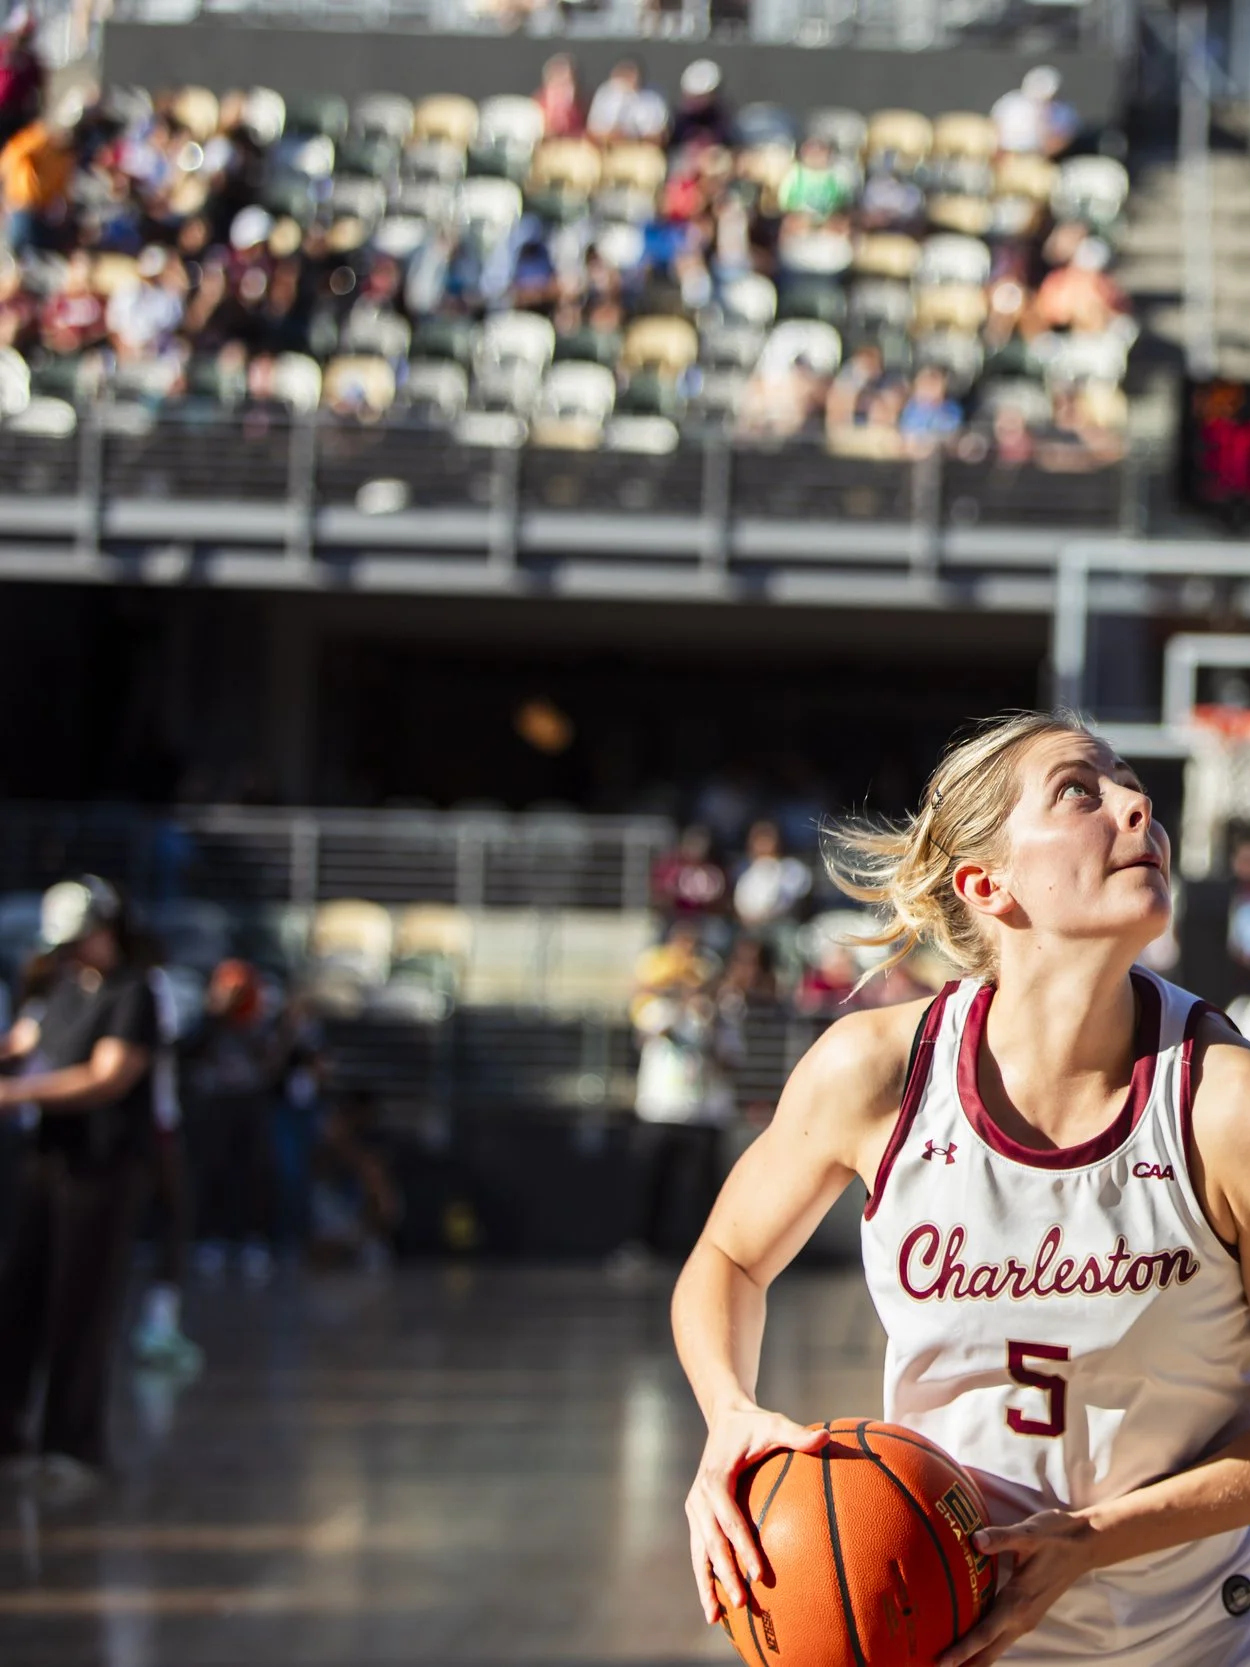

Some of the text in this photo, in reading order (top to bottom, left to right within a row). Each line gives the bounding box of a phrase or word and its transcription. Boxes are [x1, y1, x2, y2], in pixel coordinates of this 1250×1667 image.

[1132, 1161, 1175, 1181] CAA
[898, 1219, 1200, 1303] Charleston
[1005, 1338, 1071, 1438] 5
